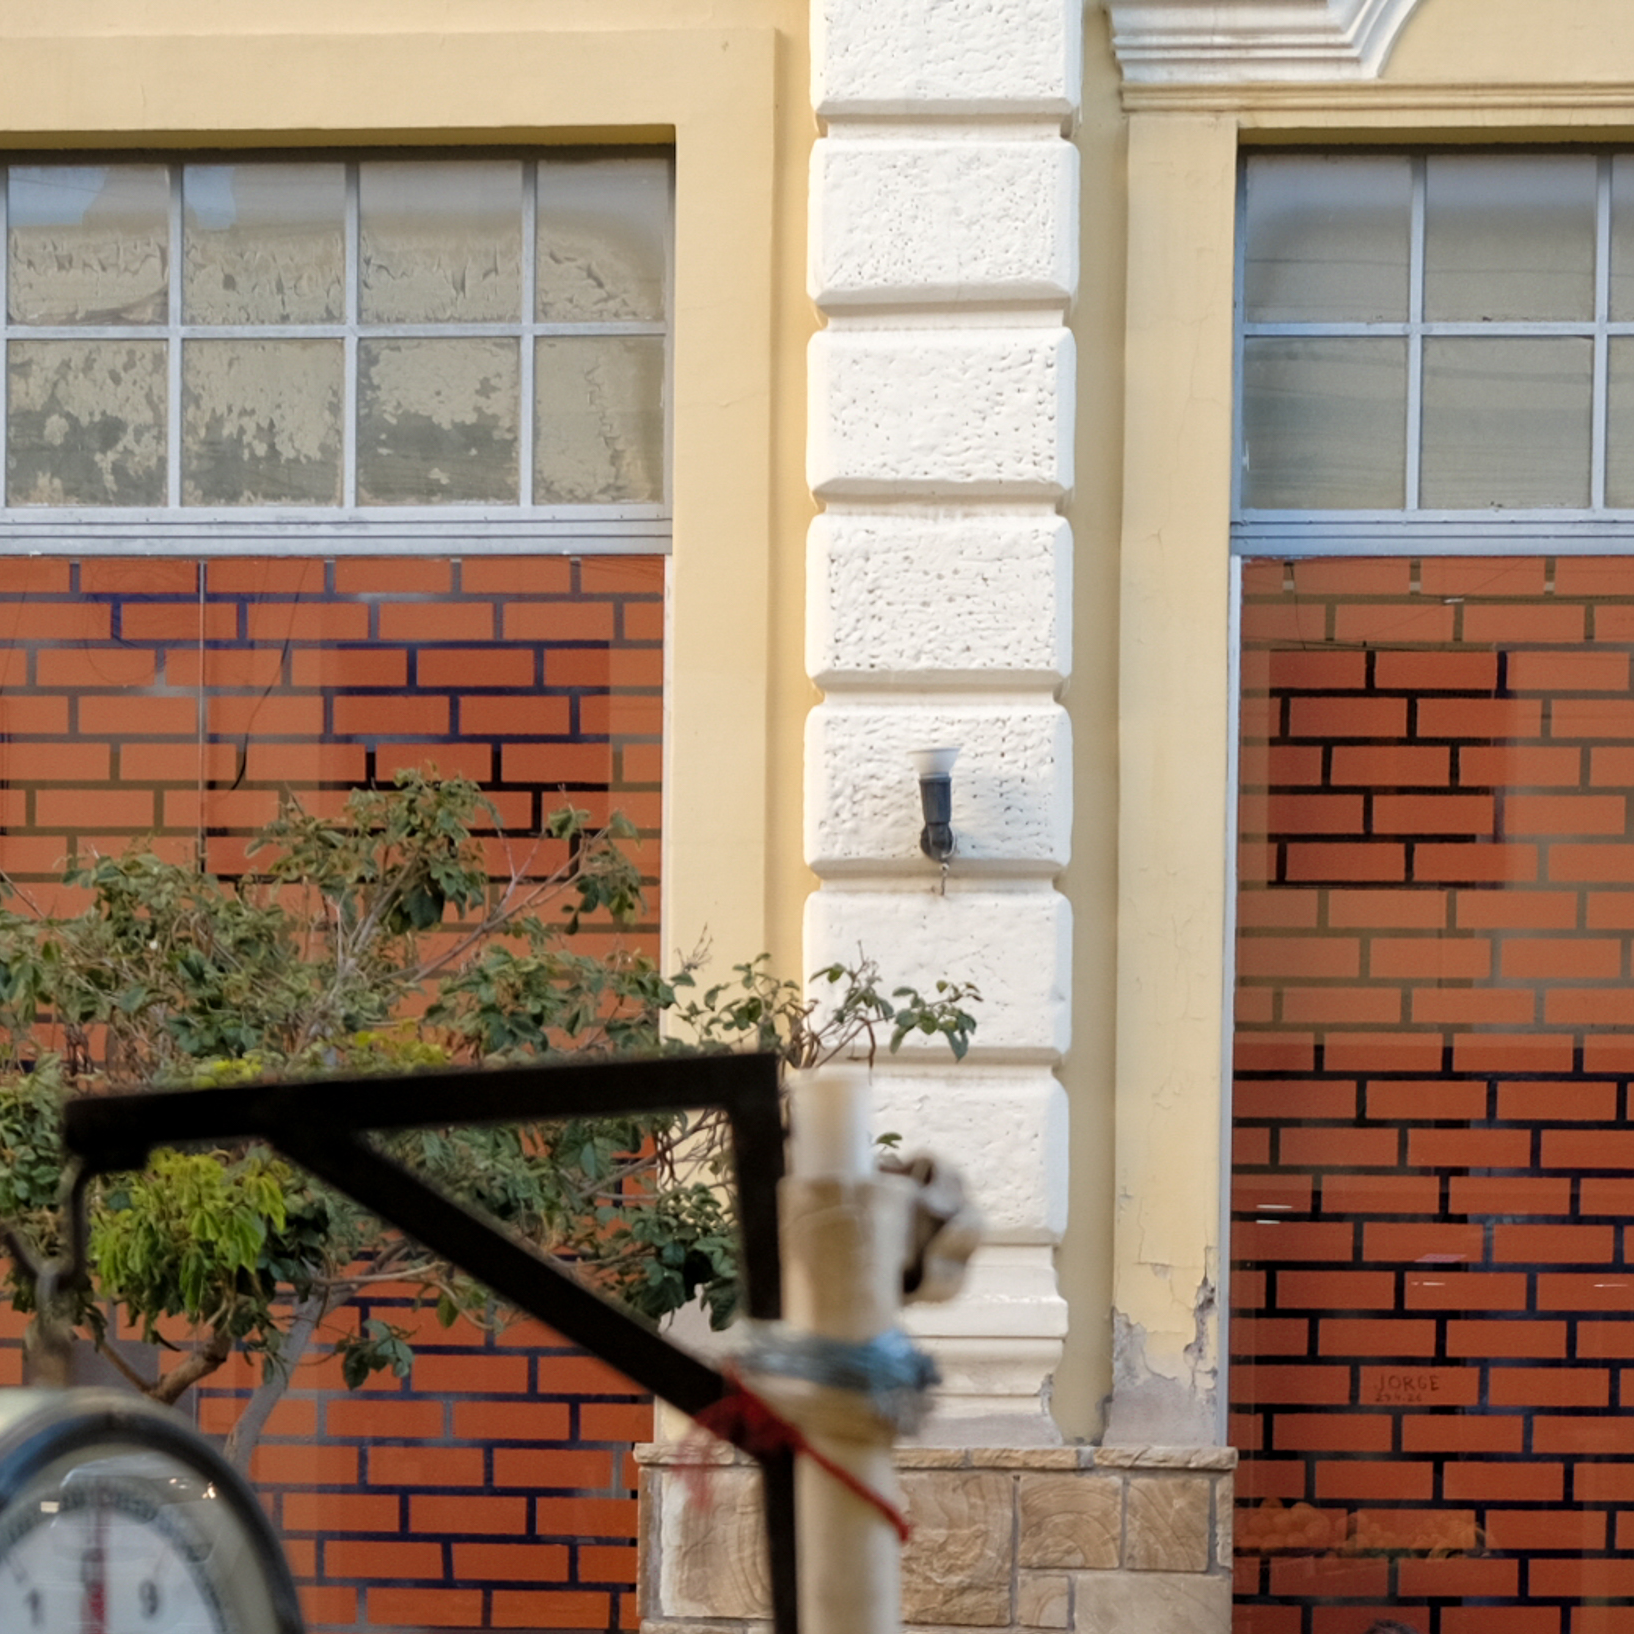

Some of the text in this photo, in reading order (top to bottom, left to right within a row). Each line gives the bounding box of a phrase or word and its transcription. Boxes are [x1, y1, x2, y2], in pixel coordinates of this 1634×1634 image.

[1373, 1374, 1440, 1391] JORGE
[24, 1586, 44, 1628] 1
[138, 1578, 160, 1621] 9
